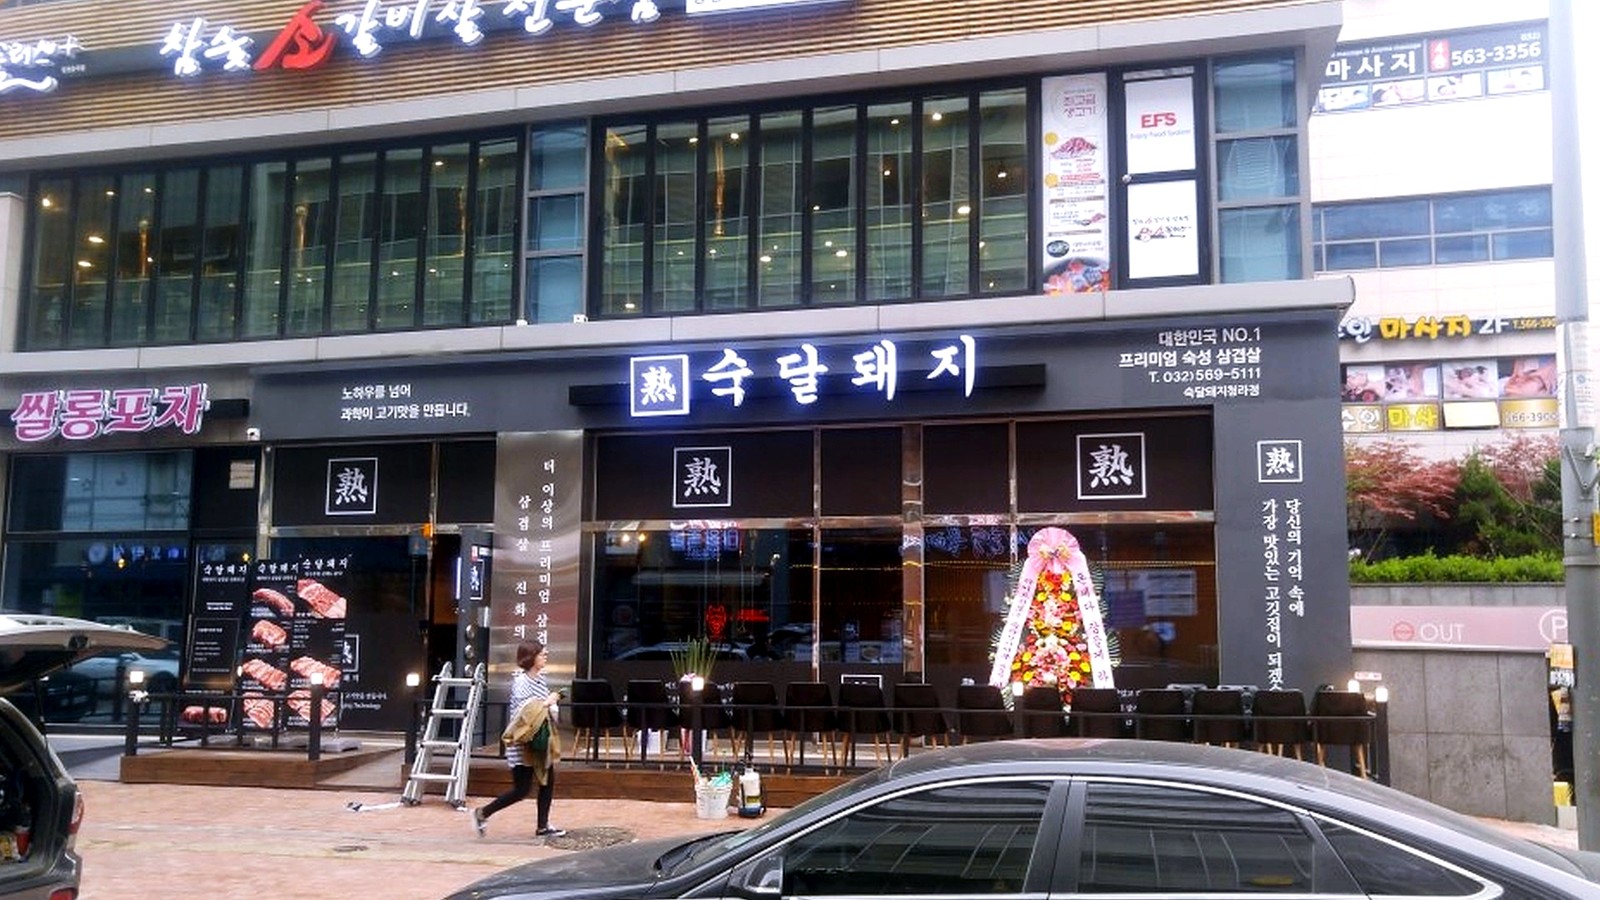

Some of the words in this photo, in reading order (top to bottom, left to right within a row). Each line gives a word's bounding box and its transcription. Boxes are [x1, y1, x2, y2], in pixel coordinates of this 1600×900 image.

[1325, 50, 1415, 80] 마사지
[1451, 41, 1541, 67] 563-3356
[1141, 112, 1177, 128] EFS
[1158, 328, 1217, 347] 대한민국
[1222, 326, 1261, 343] NO.1
[1378, 314, 1472, 340] 마사지
[1478, 318, 1509, 334] 2F
[701, 334, 976, 407] 숙달돼지
[1119, 350, 1177, 368] 프리미엄
[1181, 348, 1211, 366] 숙성
[1215, 346, 1262, 364] 삼겹살
[341, 384, 386, 400] 노하우를
[388, 383, 411, 398] 넘어
[640, 365, 678, 406] 熟
[10, 382, 209, 442] 쌀롱포차
[340, 405, 374, 421] 과학이
[375, 404, 420, 420] 고기맛을
[543, 459, 555, 474] 더
[683, 456, 722, 499] 熟
[1089, 443, 1134, 489] 熟
[335, 467, 369, 506] 熟
[540, 483, 555, 531] 이상의
[1261, 498, 1279, 531] 가장
[1285, 498, 1302, 545] 당신의
[538, 540, 552, 604] 프리미엄
[1263, 534, 1281, 582] 맛있는
[1287, 549, 1303, 582] 기억
[513, 581, 528, 640] 진화의
[1287, 585, 1306, 618] 속에
[1420, 623, 1465, 642] OUT
